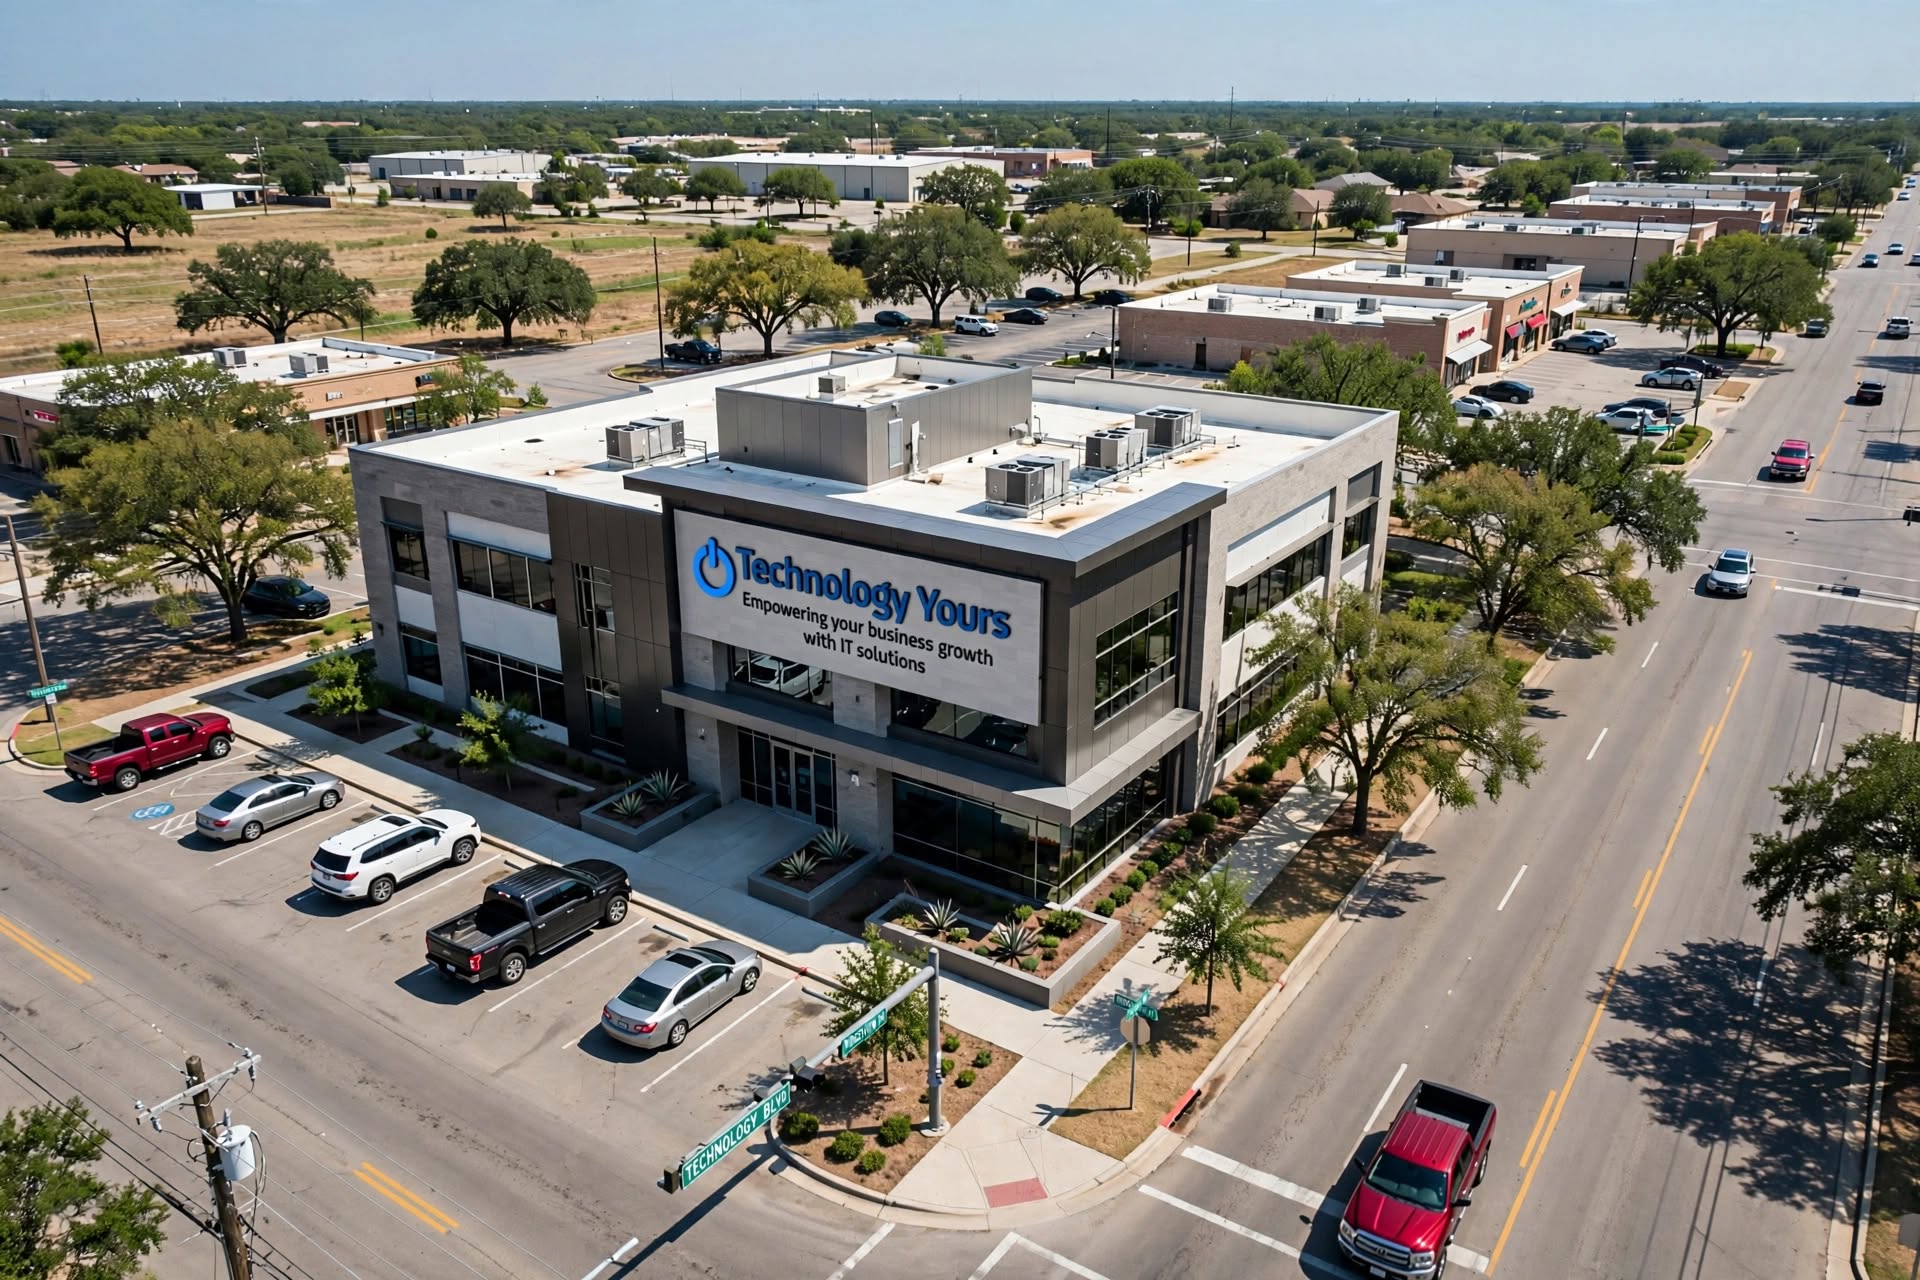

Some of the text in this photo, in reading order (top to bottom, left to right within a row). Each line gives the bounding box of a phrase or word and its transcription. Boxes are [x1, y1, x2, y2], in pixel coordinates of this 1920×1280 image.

[735, 546, 1012, 640] Technology Yours
[743, 592, 994, 667] Empowering your business growth
[803, 631, 926, 673] with IT solutions
[685, 1090, 787, 1181] TECHNOLOGY BLVD
